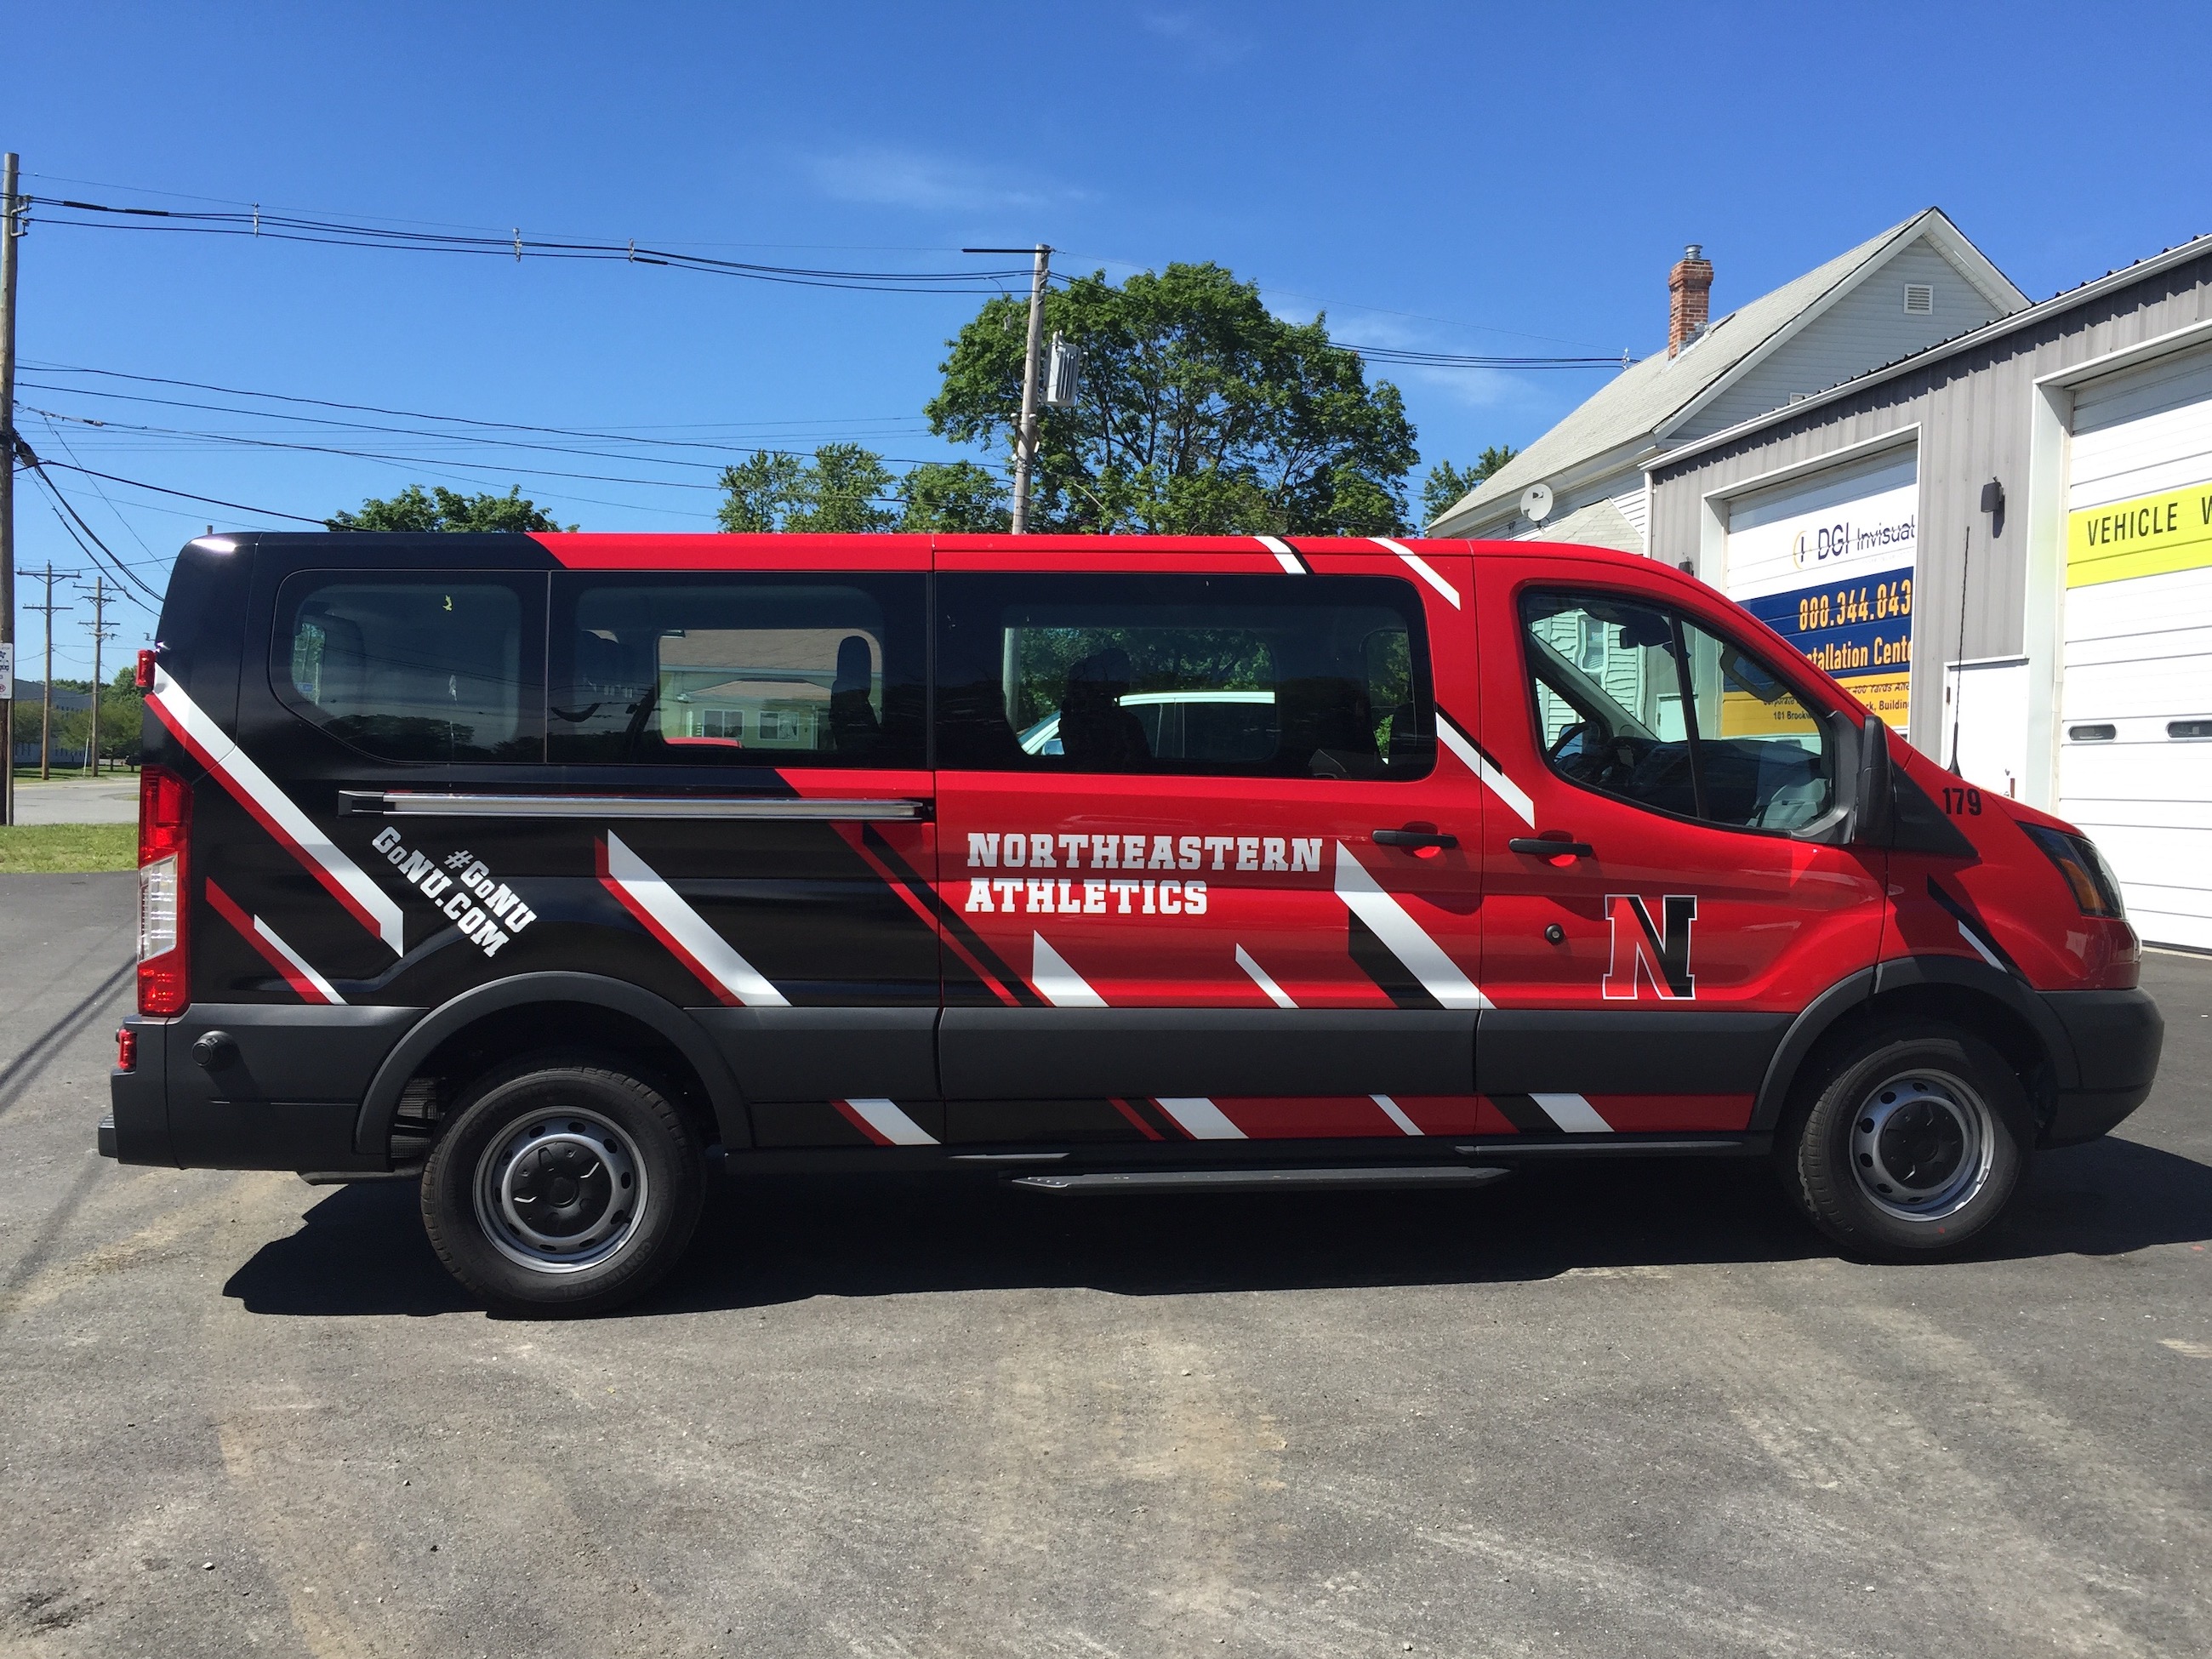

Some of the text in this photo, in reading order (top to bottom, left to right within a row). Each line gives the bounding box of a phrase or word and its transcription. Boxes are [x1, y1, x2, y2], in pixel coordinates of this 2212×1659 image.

[1818, 522, 1850, 561] DGI
[2087, 502, 2178, 546] VEHICLE
[1942, 787, 1982, 816] 179
[966, 832, 1323, 873] NORTHEASTERN
[372, 826, 510, 958] GoNU.COM
[444, 849, 538, 933] #GoNU
[964, 877, 1208, 915] ATHLETICS
[1602, 893, 1698, 1001] N
